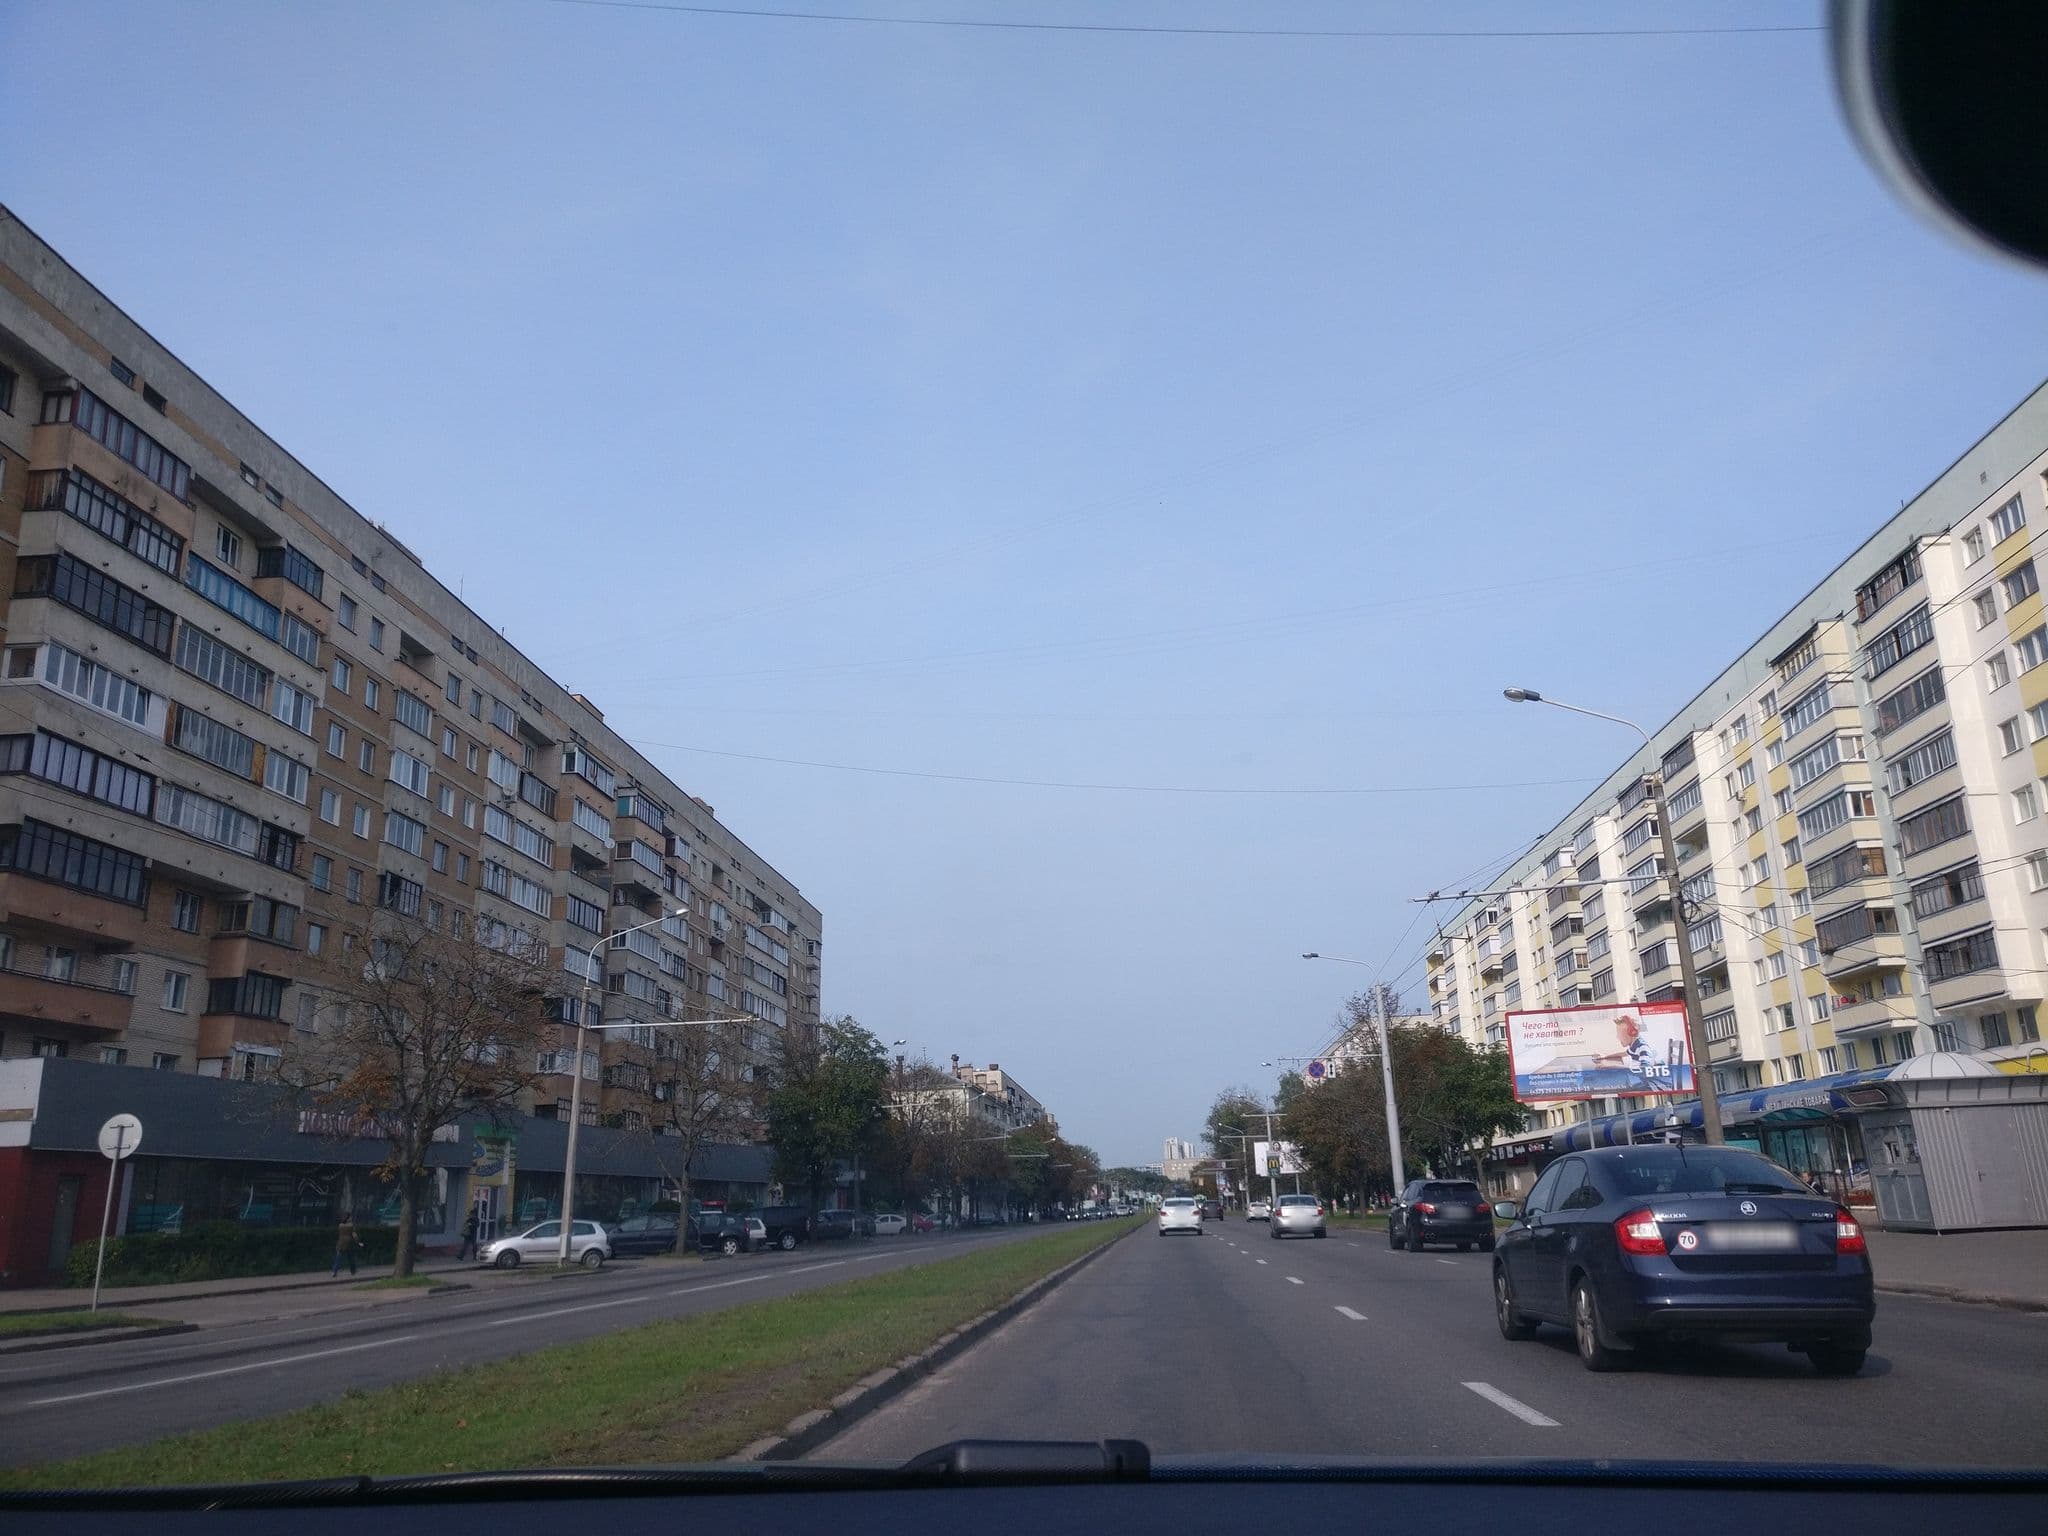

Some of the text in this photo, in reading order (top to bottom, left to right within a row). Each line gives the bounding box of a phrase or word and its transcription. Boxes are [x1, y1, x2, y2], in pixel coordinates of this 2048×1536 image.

[1522, 1021, 1559, 1030] Чего-то
[1535, 1029, 1577, 1039] хватает
[1645, 1066, 1671, 1078] ВТБ
[1680, 1235, 1695, 1245] 70
